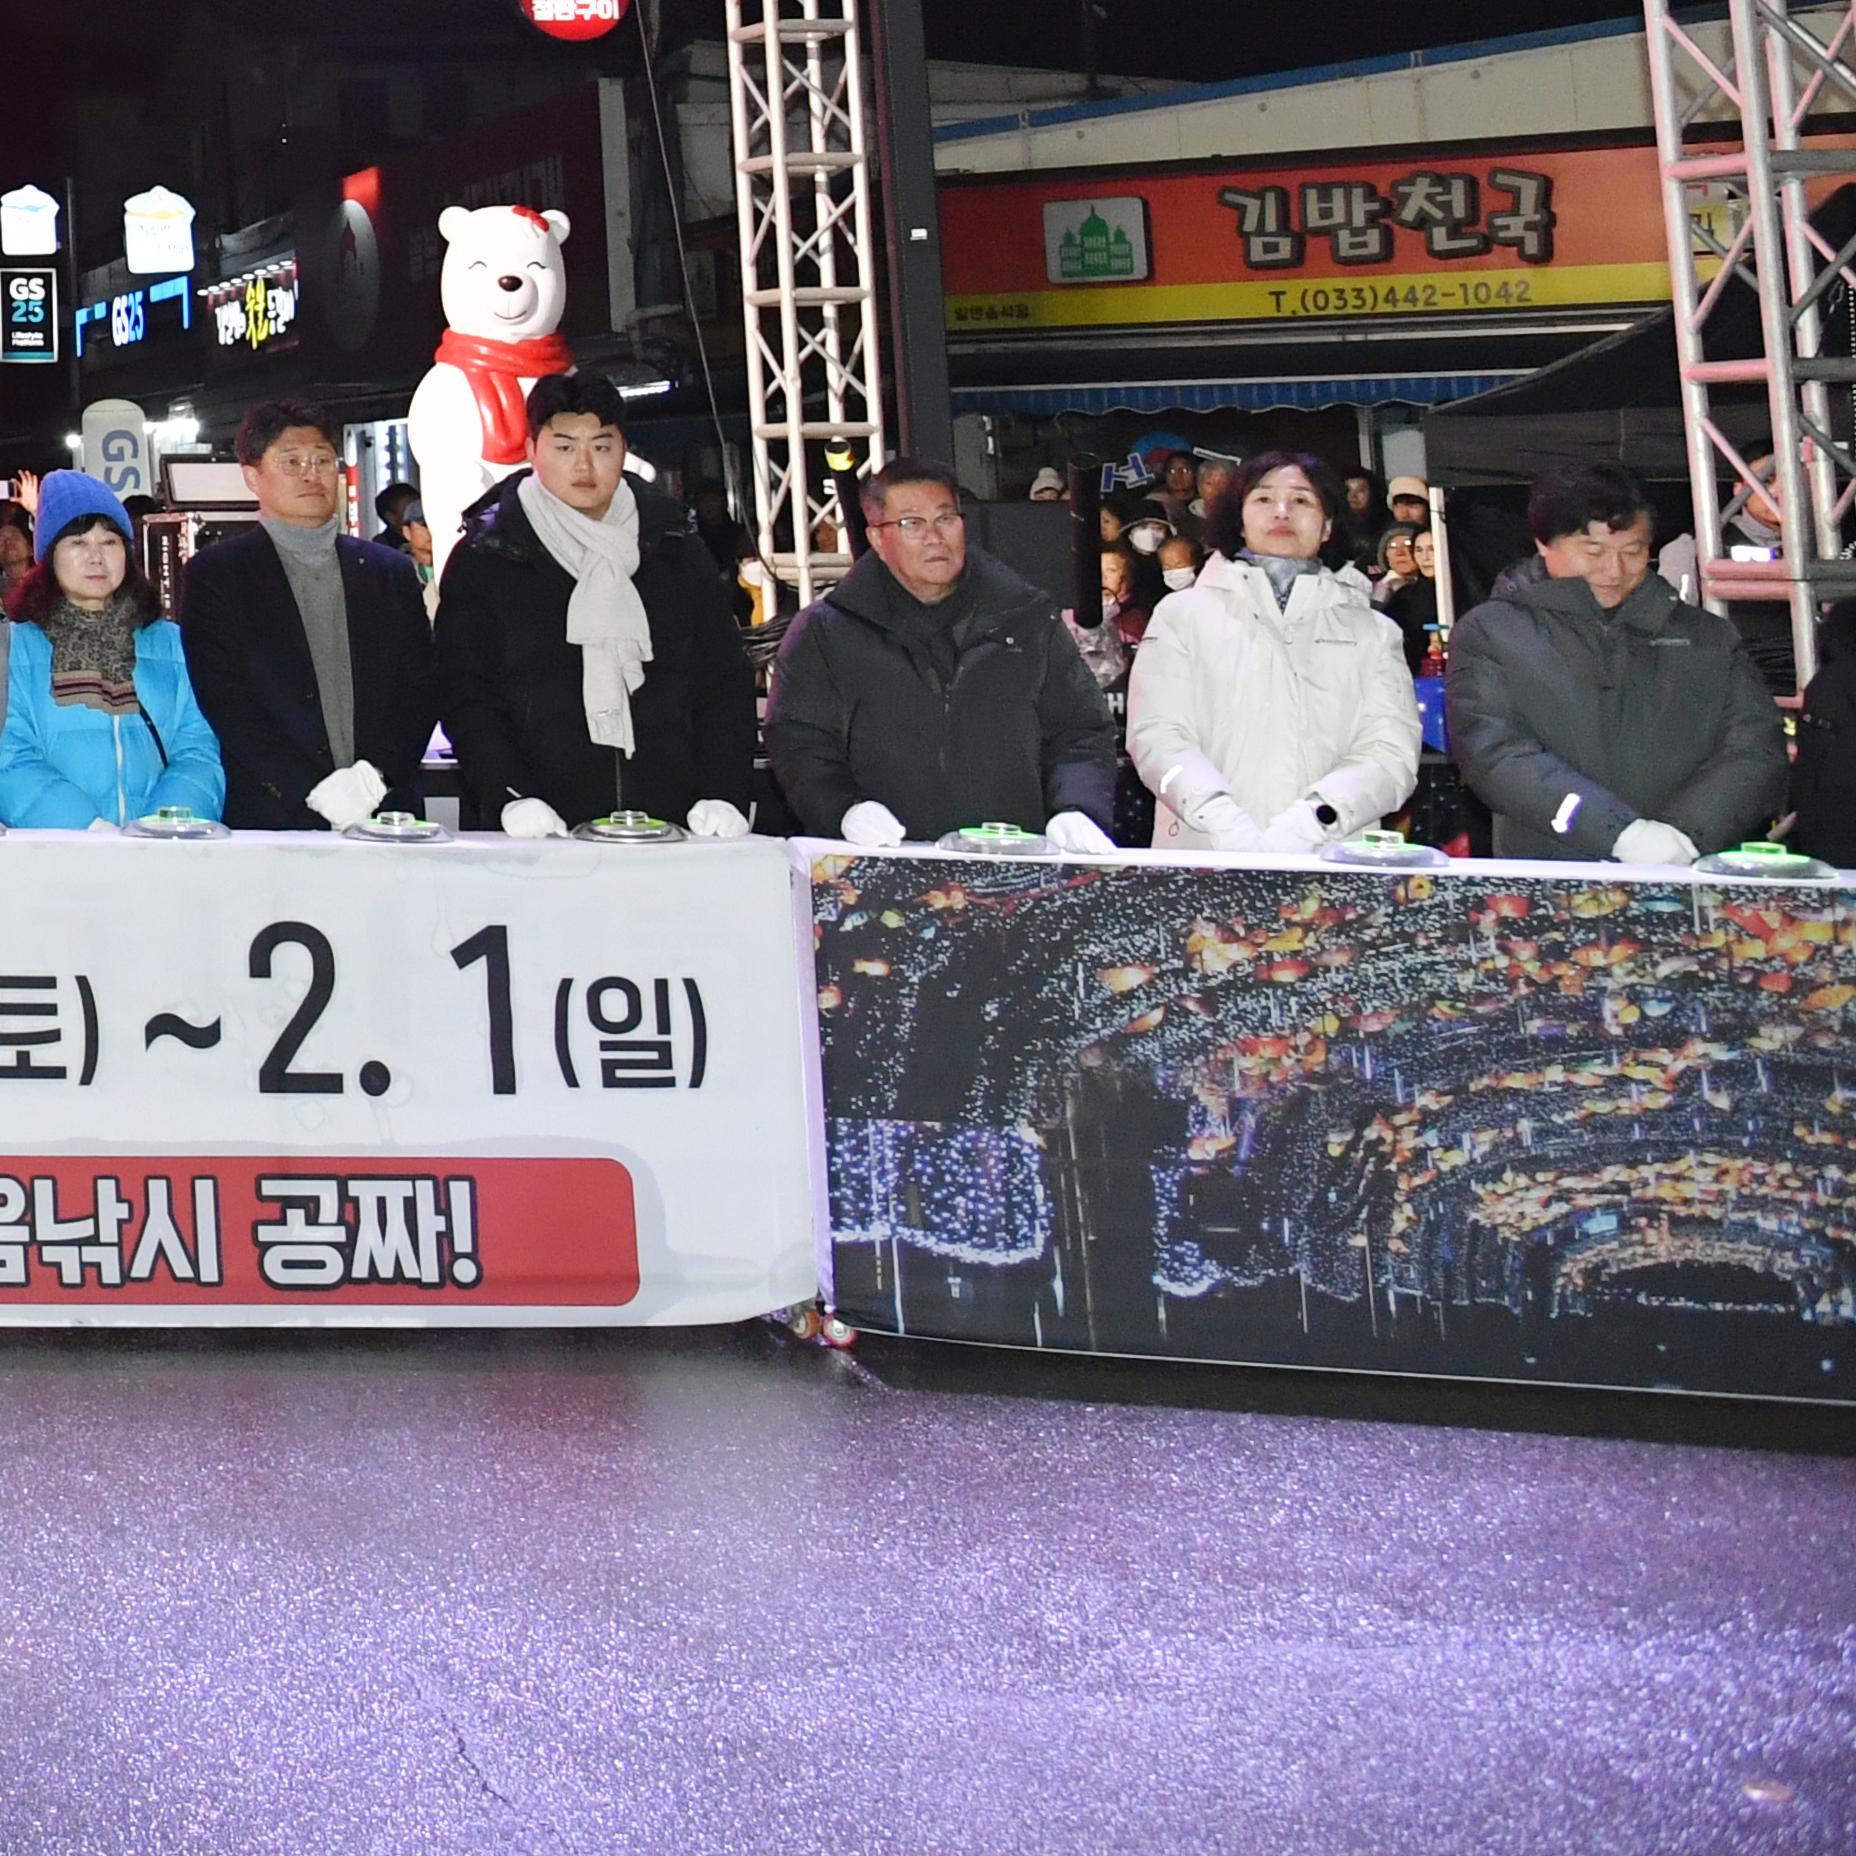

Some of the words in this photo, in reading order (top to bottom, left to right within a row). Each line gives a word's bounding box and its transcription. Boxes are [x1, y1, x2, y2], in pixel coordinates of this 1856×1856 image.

[1219, 168, 1551, 266] 김밥천국
[9, 277, 46, 301] GS
[11, 300, 45, 323] 25
[111, 291, 145, 347] GS25
[257, 1179, 479, 1287] 공짜!
